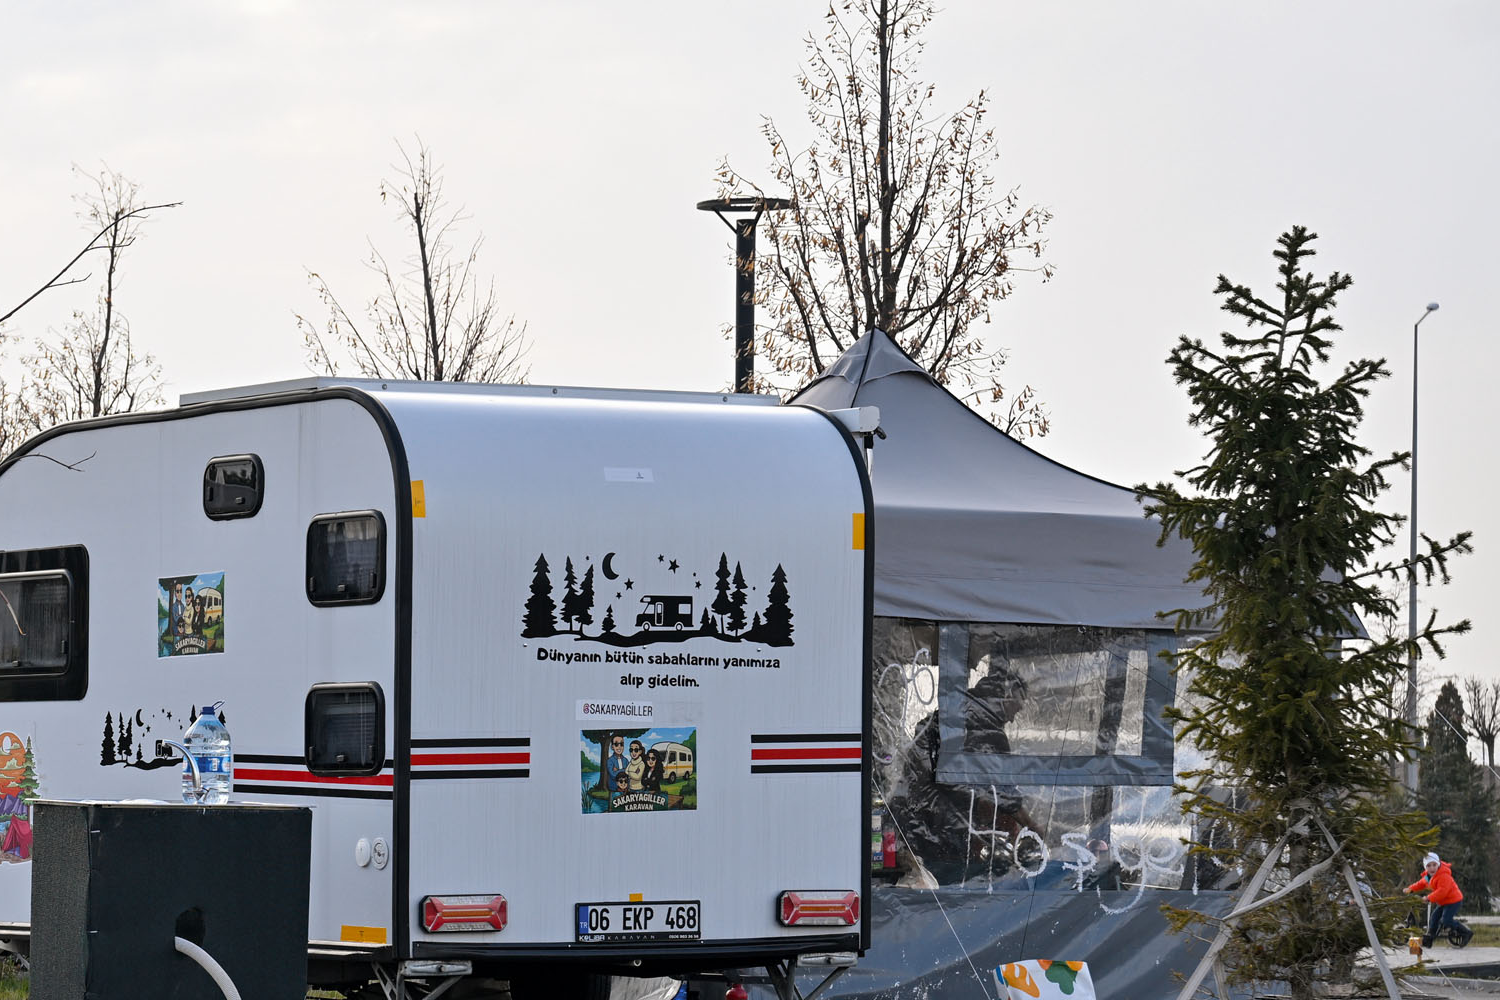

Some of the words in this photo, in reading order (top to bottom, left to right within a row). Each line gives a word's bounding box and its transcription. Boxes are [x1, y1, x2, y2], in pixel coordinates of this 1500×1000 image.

[537, 648, 601, 664] Dünyanın
[605, 651, 644, 665] bütün
[647, 652, 720, 667] sabahlarını
[723, 656, 781, 669] yanımıza
[620, 673, 644, 689] alıp
[648, 673, 700, 689] gidelim.
[625, 803, 654, 811] KARAVAN
[579, 921, 588, 929] TR
[588, 908, 610, 931] 06
[622, 907, 654, 930] EKP
[665, 906, 697, 929] 468
